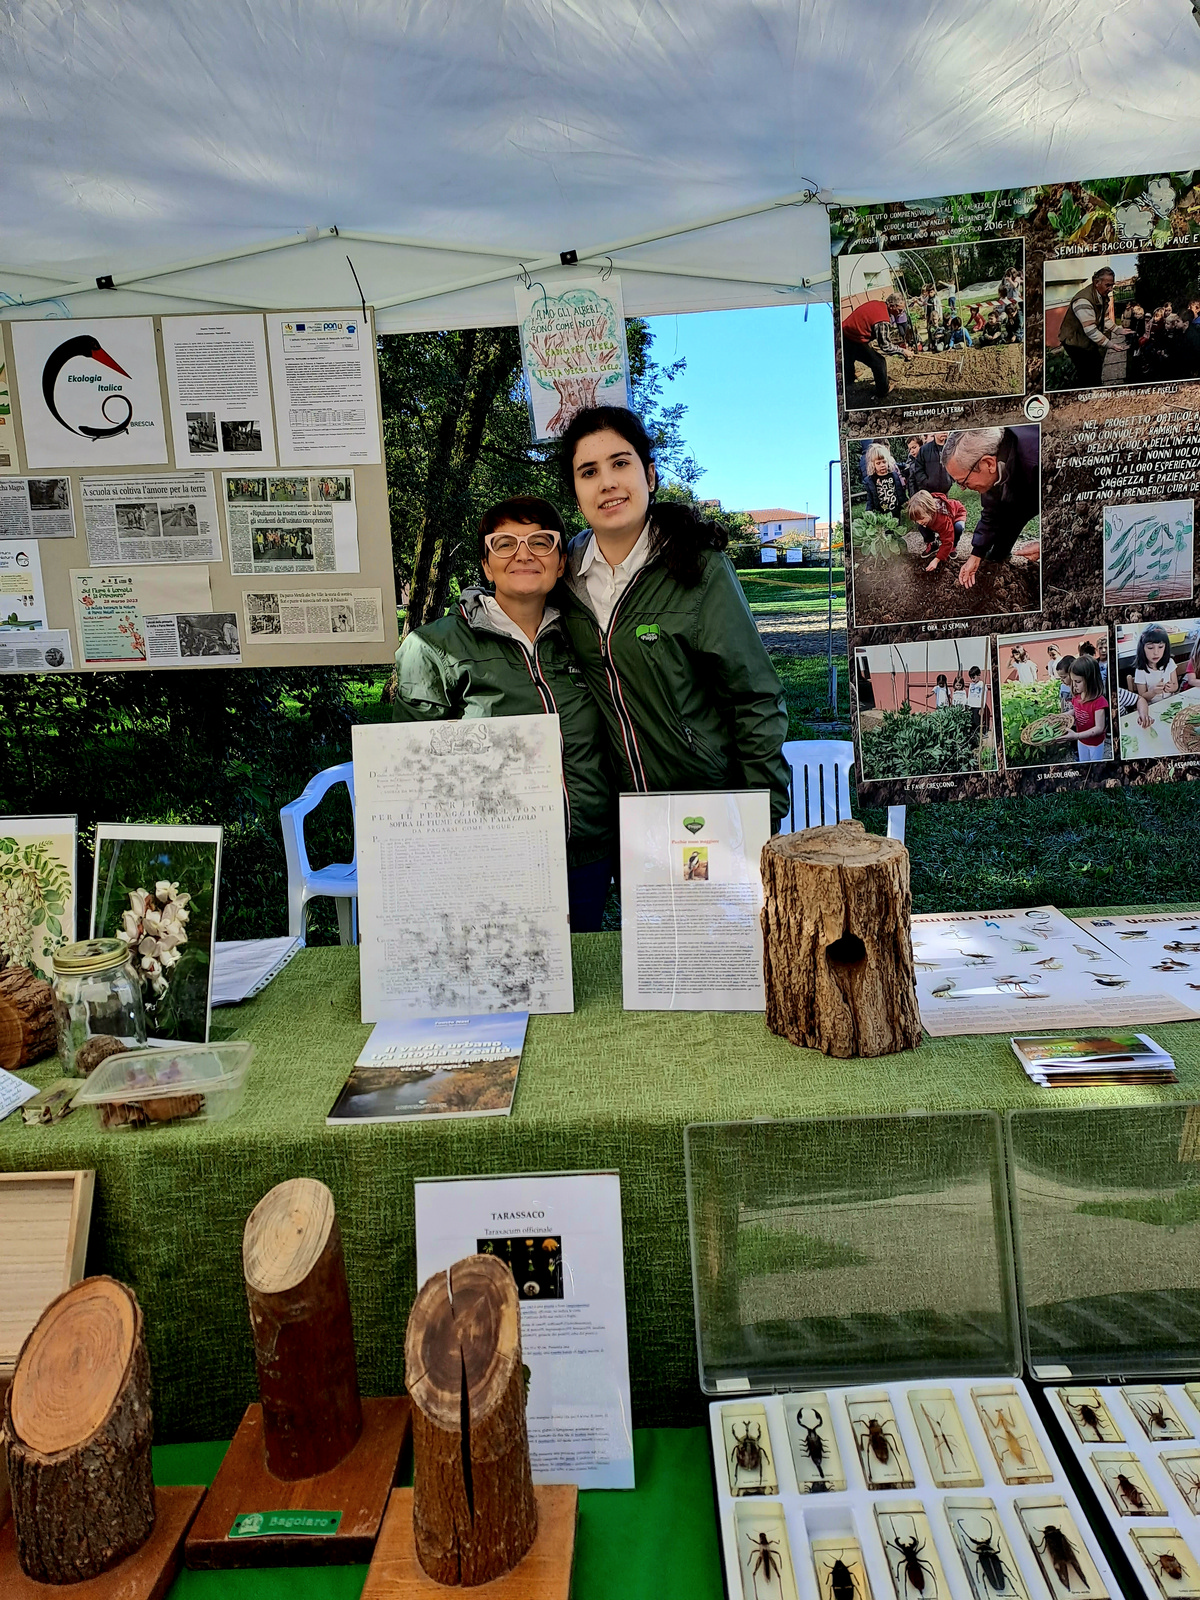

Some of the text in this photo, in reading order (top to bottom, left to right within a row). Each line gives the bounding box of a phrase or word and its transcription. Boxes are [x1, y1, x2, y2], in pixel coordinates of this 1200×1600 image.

[890, 210, 927, 219] COMPRENSIVO
[854, 235, 888, 245] PROGETTO
[948, 226, 982, 236] SCOLASTICO
[984, 220, 1015, 231] 2016-17
[884, 223, 904, 232] SCUOLA
[1054, 234, 1200, 258] SEMINA E RACCOLTA DI FAVE E
[536, 309, 555, 321] AMO
[558, 307, 571, 318] GLI
[530, 323, 552, 334] SONO
[556, 320, 574, 332] COME
[545, 342, 614, 357] RADICI PER TERRA
[68, 374, 102, 384] Ekologia
[537, 369, 562, 378] TESTA
[565, 366, 588, 376] VERSO
[98, 384, 122, 392] Italica
[1078, 392, 1112, 402] OSSERVIAMO
[1116, 390, 1129, 398] SEMI
[1158, 386, 1178, 394] PISELLI
[904, 408, 936, 418] PREPARIAMO
[946, 406, 964, 414] TERRA
[1083, 420, 1098, 430] NEL
[1104, 414, 1151, 428] PROGETTO
[1070, 422, 1192, 446] SONO COINVOLTI BAMBINI E
[1087, 443, 1112, 454] DELLA
[1112, 439, 1148, 452] SCUOLA
[1056, 449, 1172, 469] LE INSEGNANTI E I NONNI
[1094, 466, 1112, 476] CON
[1116, 464, 1128, 476] LA
[1130, 462, 1153, 474] LORO
[9, 484, 26, 492] Magna
[1098, 474, 1155, 490] SAGGEZZA E
[82, 488, 88, 496] A
[90, 487, 111, 496] scuola
[112, 487, 118, 496] si
[120, 486, 141, 495] coltiva
[142, 485, 168, 494] l'amore
[170, 486, 181, 495] per
[182, 484, 189, 492] la
[1062, 492, 1072, 502] CI
[1076, 489, 1114, 502] AIUTANO
[1116, 488, 1121, 498] A
[1123, 485, 1164, 497] PRENDERCI
[1167, 484, 1188, 494] CURA
[303, 517, 332, 525] comprensivo
[942, 624, 948, 632] SI
[371, 814, 393, 822] PER
[420, 810, 480, 820] PEDAGGIO
[516, 804, 555, 814] PONTE
[490, 814, 537, 823] PALAZZOLO
[370, 1053, 394, 1061] tra
[399, 1049, 448, 1059] utopia
[466, 1046, 512, 1055] realtà
[384, 1040, 502, 1054] Il verde urbano
[491, 1211, 545, 1220] TARASSACO
[484, 1228, 521, 1236] Taraxacum
[268, 1516, 328, 1528] Bagolaro
